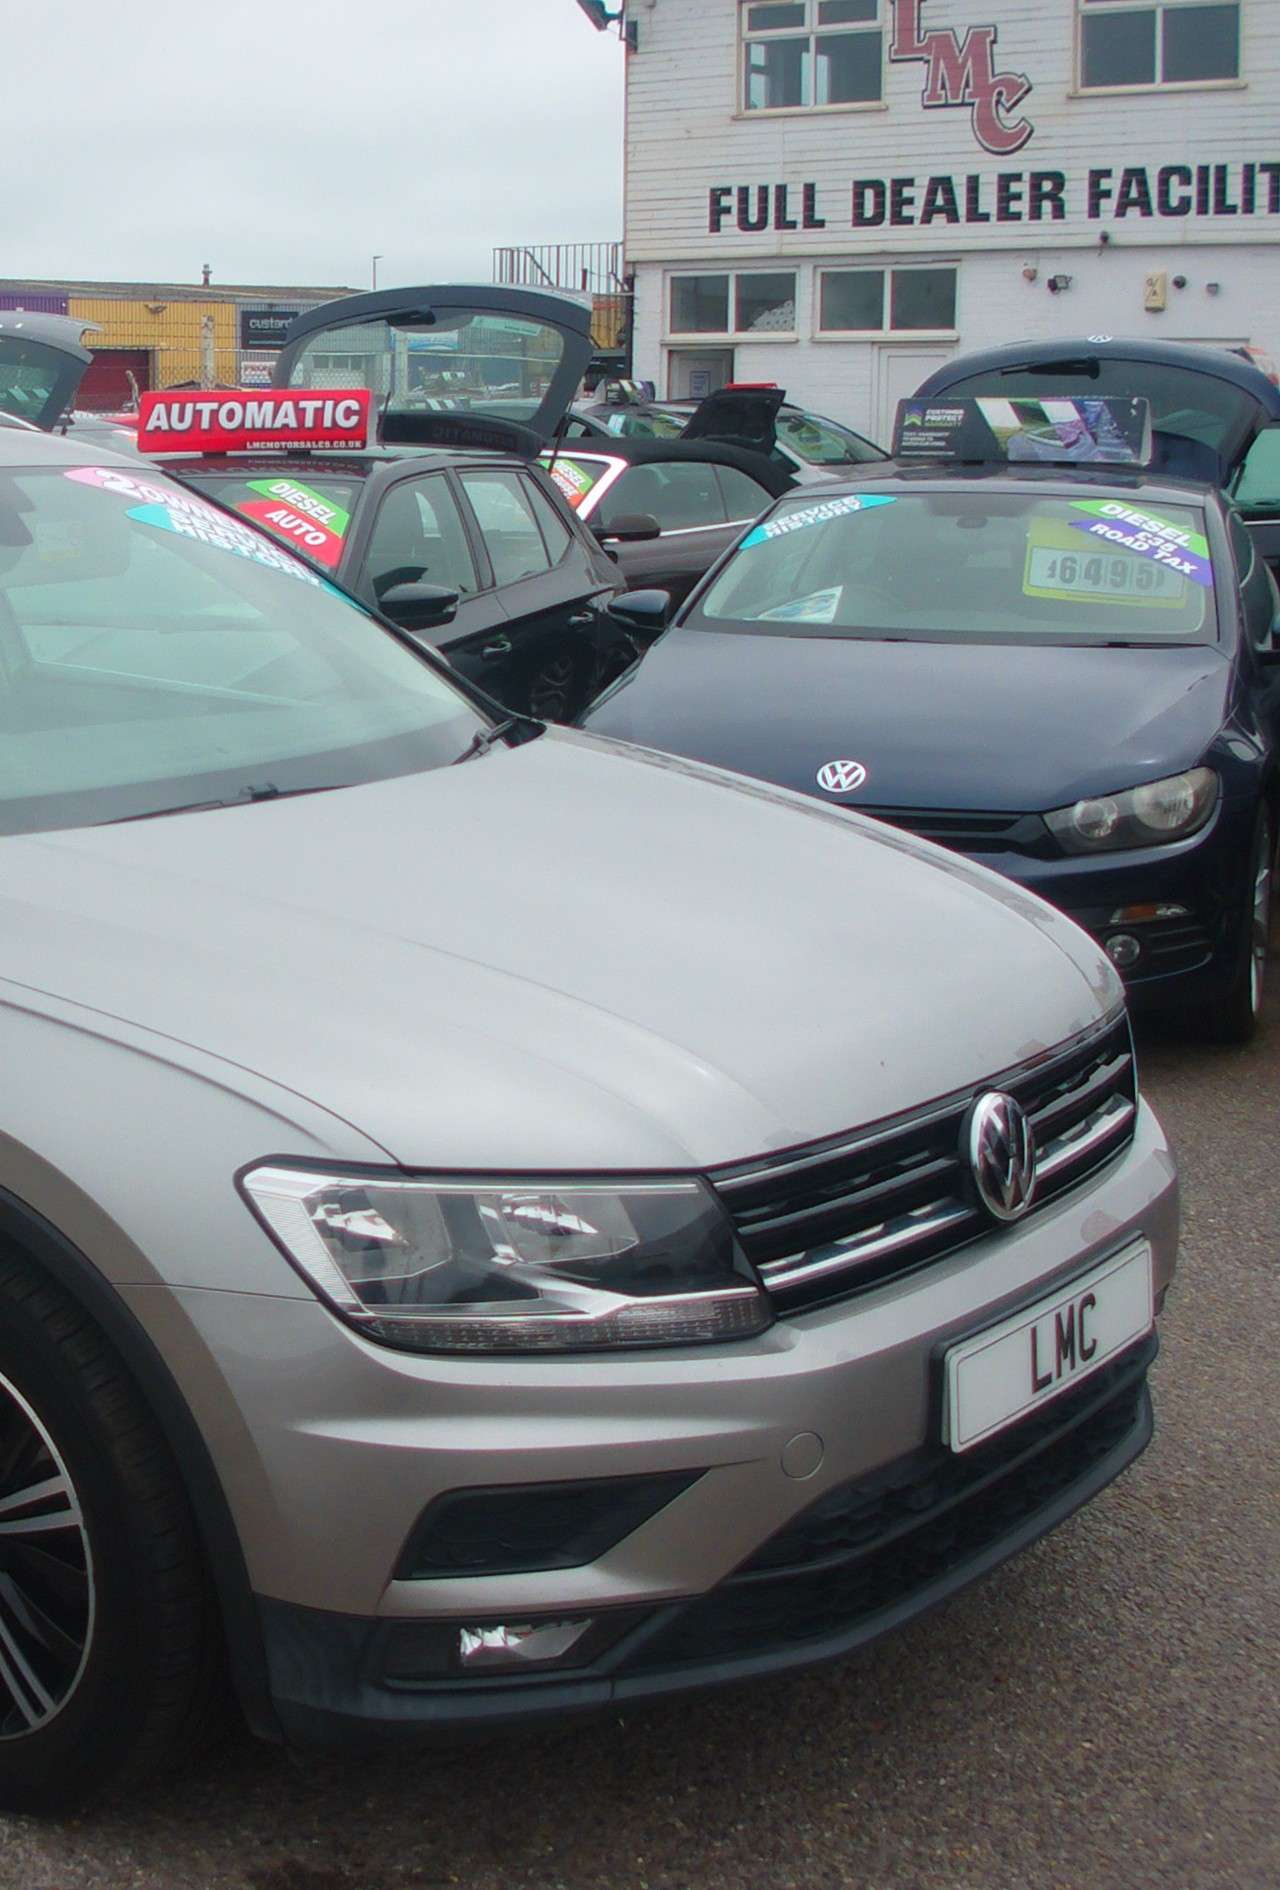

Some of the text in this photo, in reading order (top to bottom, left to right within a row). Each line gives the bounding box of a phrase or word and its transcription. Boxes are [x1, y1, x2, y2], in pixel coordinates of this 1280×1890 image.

[889, 0, 1034, 156] LMC
[708, 162, 1280, 233] FULL DEALER FACILIT
[145, 399, 360, 431] AUTOMATIC
[264, 509, 327, 545] AUTO
[268, 482, 336, 526] DIESEL
[1099, 503, 1192, 547] DIESEL
[1089, 523, 1198, 574] ROAD TAX
[1030, 1293, 1097, 1395] LMC
